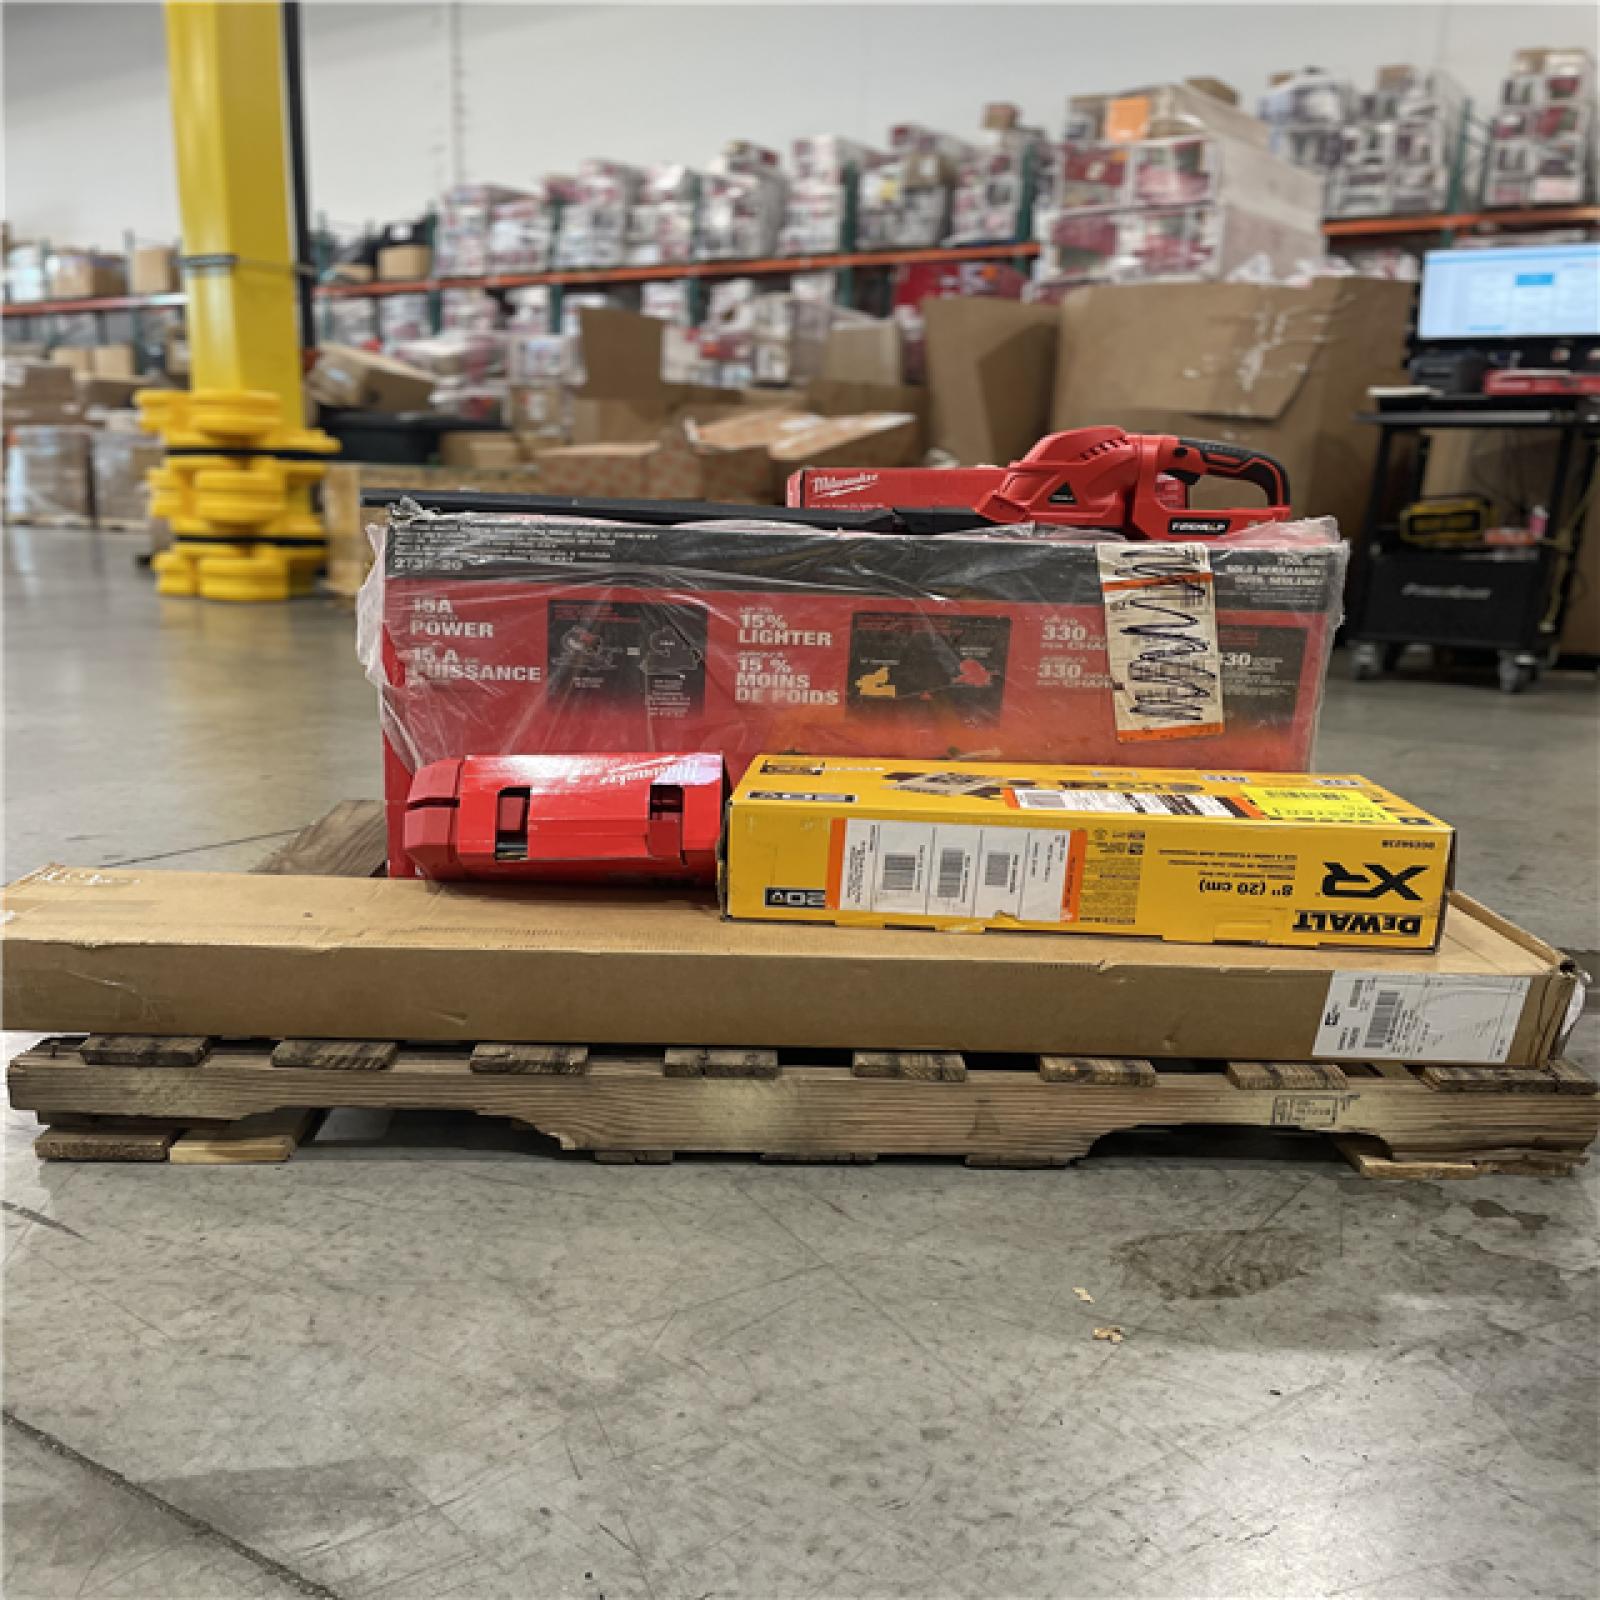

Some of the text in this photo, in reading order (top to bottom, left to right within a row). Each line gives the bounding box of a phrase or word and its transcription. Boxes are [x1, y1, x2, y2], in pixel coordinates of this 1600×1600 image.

[410, 620, 494, 638] POWER
[1042, 624, 1087, 640] 330
[737, 629, 833, 646] LIGHTER
[739, 657, 764, 671] 15
[736, 672, 811, 688] MOINS
[770, 688, 839, 705] POIDS
[1199, 879, 1232, 893] cm)
[1322, 861, 1430, 901] XR
